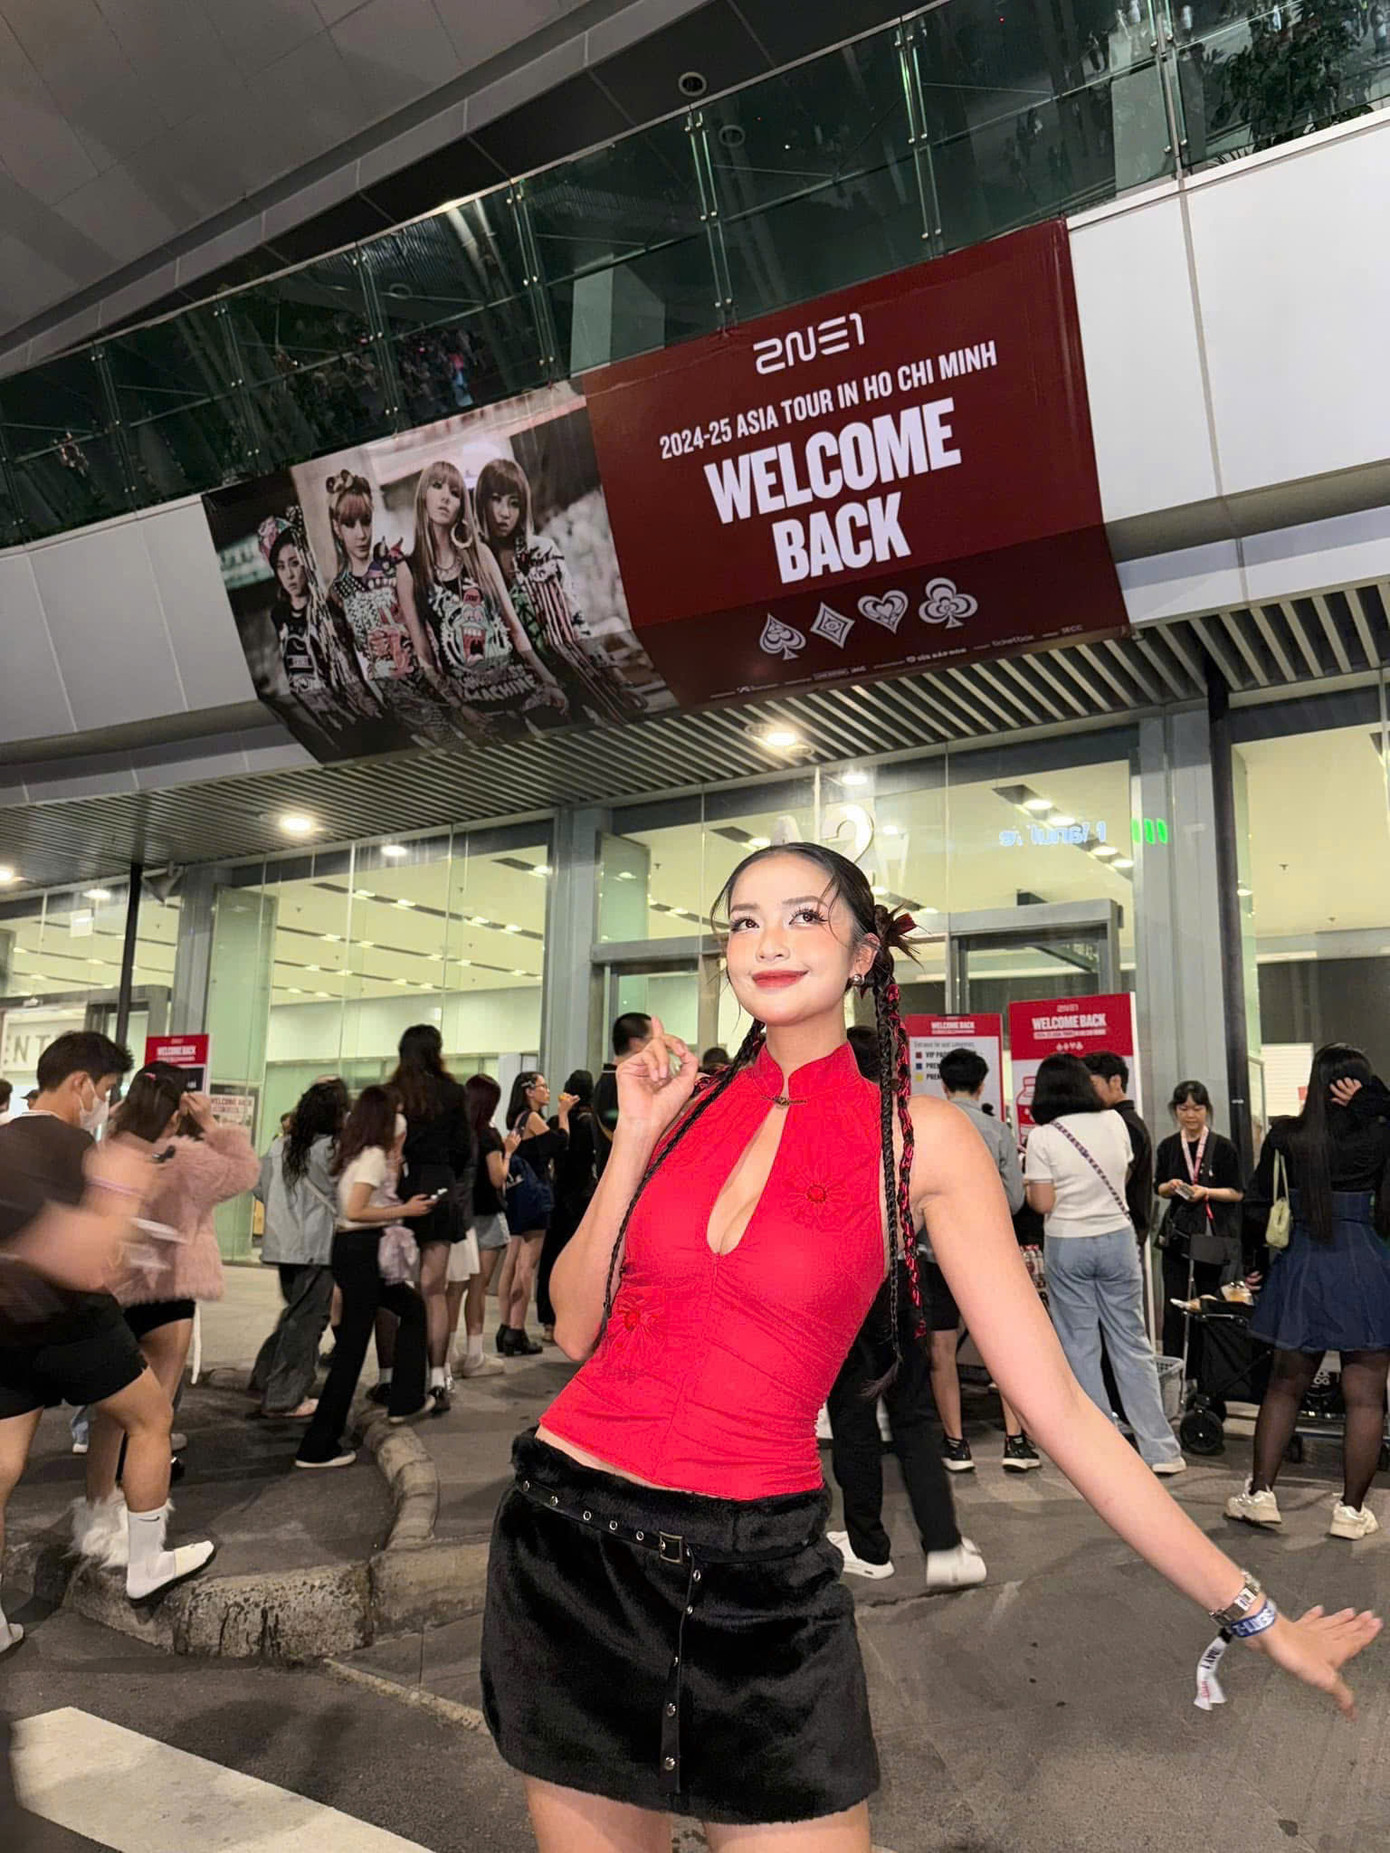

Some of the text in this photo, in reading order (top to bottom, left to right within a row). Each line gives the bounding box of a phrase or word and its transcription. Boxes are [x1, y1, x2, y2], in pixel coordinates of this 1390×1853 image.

[753, 313, 864, 374] 2NE1
[660, 340, 997, 460] 2024-25 ASIA TOUR IN HO CHI MINH
[704, 398, 962, 524] WELCOME
[772, 492, 911, 584] BACK
[1032, 1013, 1107, 1031] WELCOME BACK
